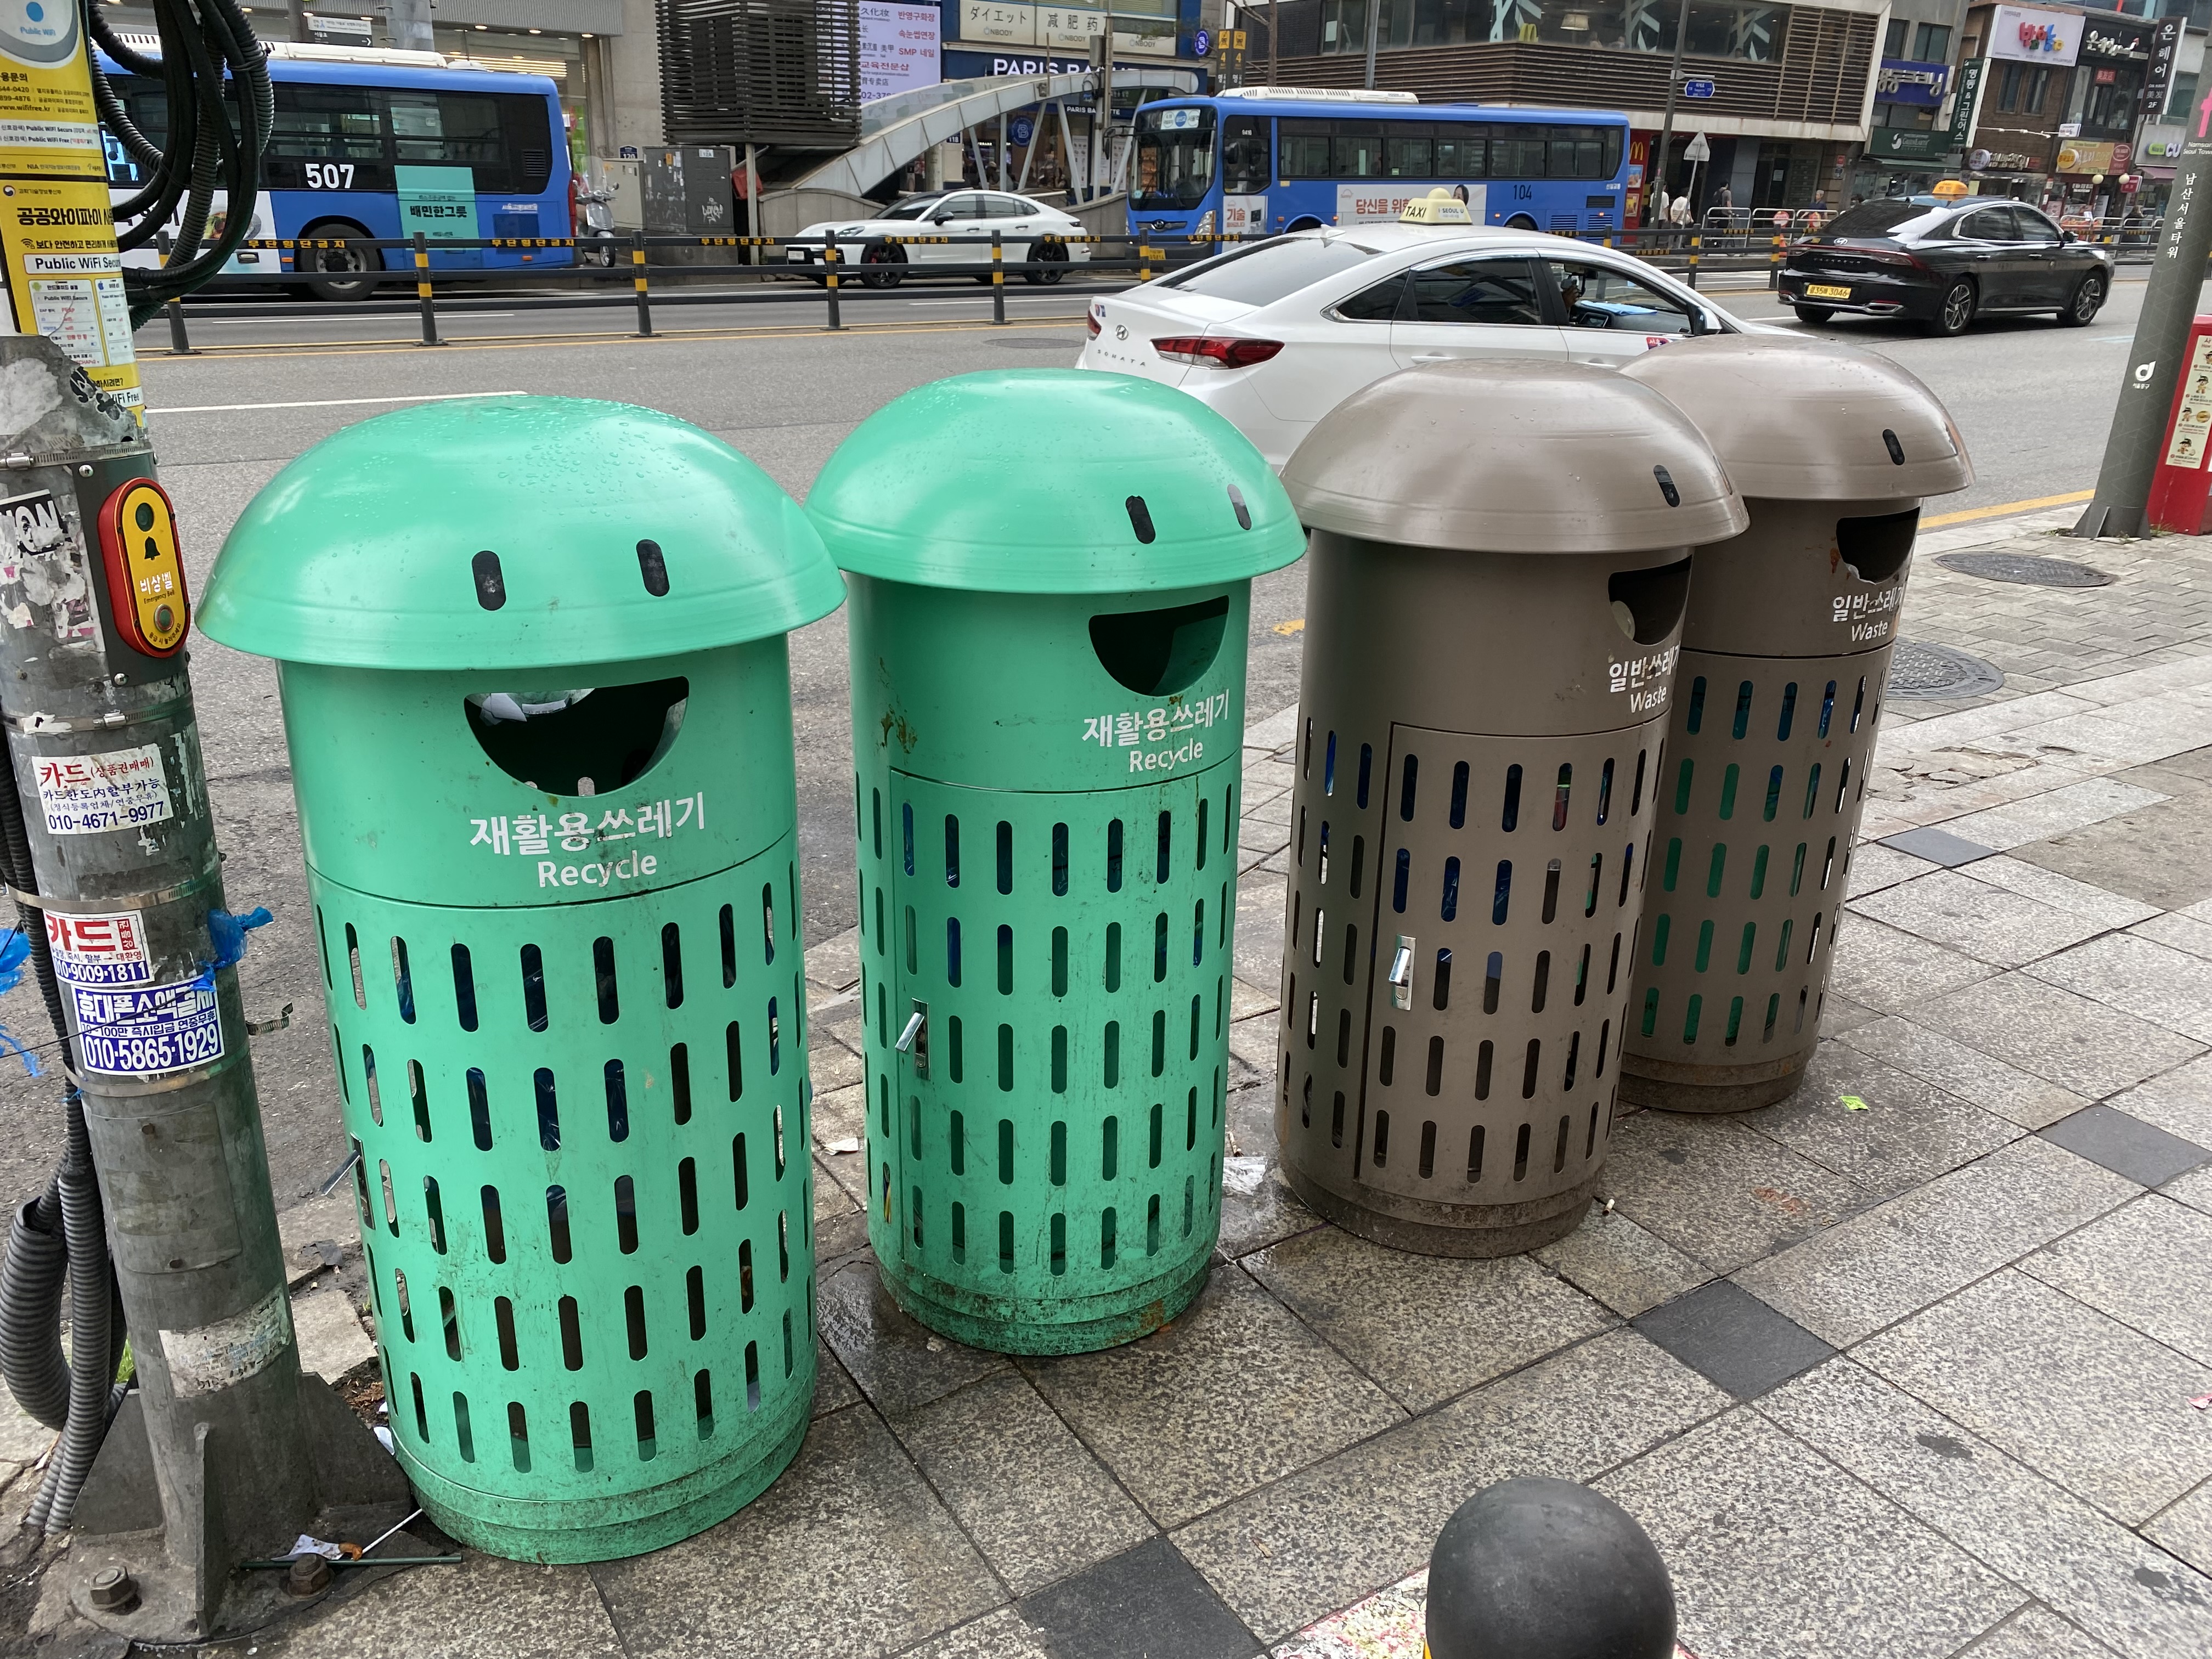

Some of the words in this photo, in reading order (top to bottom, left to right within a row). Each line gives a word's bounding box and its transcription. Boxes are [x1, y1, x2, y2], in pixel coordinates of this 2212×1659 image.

[970, 6, 1026, 25] ダイエット
[899, 48, 917, 56] SMP
[994, 58, 1059, 76] PARIS
[0, 72, 29, 82] 용문의
[2165, 143, 2181, 157] CU
[305, 163, 354, 189] 507
[1513, 184, 1532, 200] 104
[17, 207, 103, 225] 공공와이파이
[410, 205, 467, 218] 배민한그릇
[1227, 208, 1245, 221] 기술
[1356, 199, 1388, 215] 당신을
[1406, 206, 1427, 218] TAXI
[2167, 173, 2197, 259] 남산서울타워
[36, 240, 53, 249] 보다
[54, 240, 84, 249] 안전하고
[35, 258, 76, 269] Public
[78, 257, 101, 269] WiFi
[104, 257, 121, 268] Secur
[1829, 288, 1848, 297] 3046
[1097, 349, 1146, 367] SONATA
[140, 571, 173, 595] 비상벨
[144, 593, 167, 604] Emergency
[167, 589, 175, 597] Bell
[1852, 620, 1888, 642] Waste
[1609, 640, 1681, 693] 일반쓰레기
[1630, 686, 1667, 713] Waste
[1082, 689, 1229, 748] 재활용쓰레기
[1130, 738, 1203, 773] Recycle
[40, 763, 91, 788] 카드
[91, 756, 154, 778] (상품권매매)
[48, 802, 164, 830] 010-4671-9977
[470, 791, 705, 856] 재활용쓰레기
[537, 849, 658, 888] Recycle
[46, 914, 116, 952] 카드
[84, 954, 101, 964] 할부
[116, 951, 142, 961] 대환영
[131, 1024, 176, 1036] 즉시입금
[178, 1011, 216, 1030] 연중무휴
